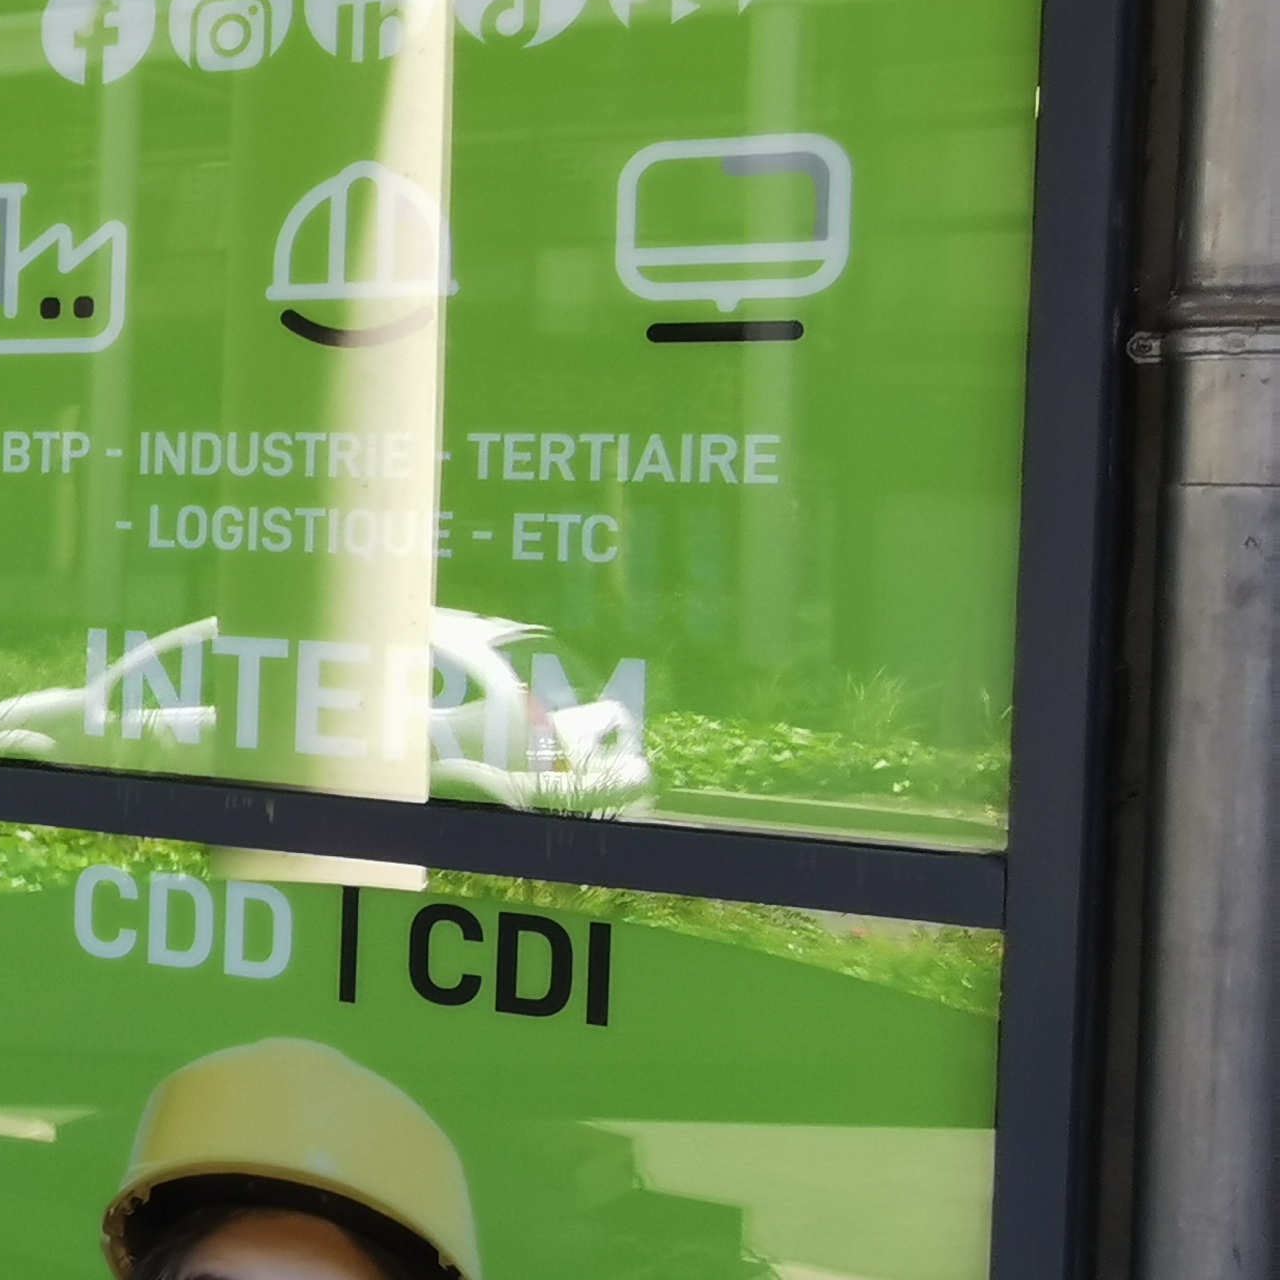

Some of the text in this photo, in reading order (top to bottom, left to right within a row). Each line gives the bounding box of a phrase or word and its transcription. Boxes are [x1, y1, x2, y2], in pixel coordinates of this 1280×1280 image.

[1, 430, 91, 474] BTP
[139, 430, 410, 479] INDUSTRIE
[467, 432, 781, 484] TERTIAIRE
[148, 504, 453, 563] LOGISTIQUE
[511, 512, 619, 563] ETC
[82, 627, 647, 772] INTERIM
[73, 863, 294, 980] CDD
[409, 903, 611, 1026] CDI
